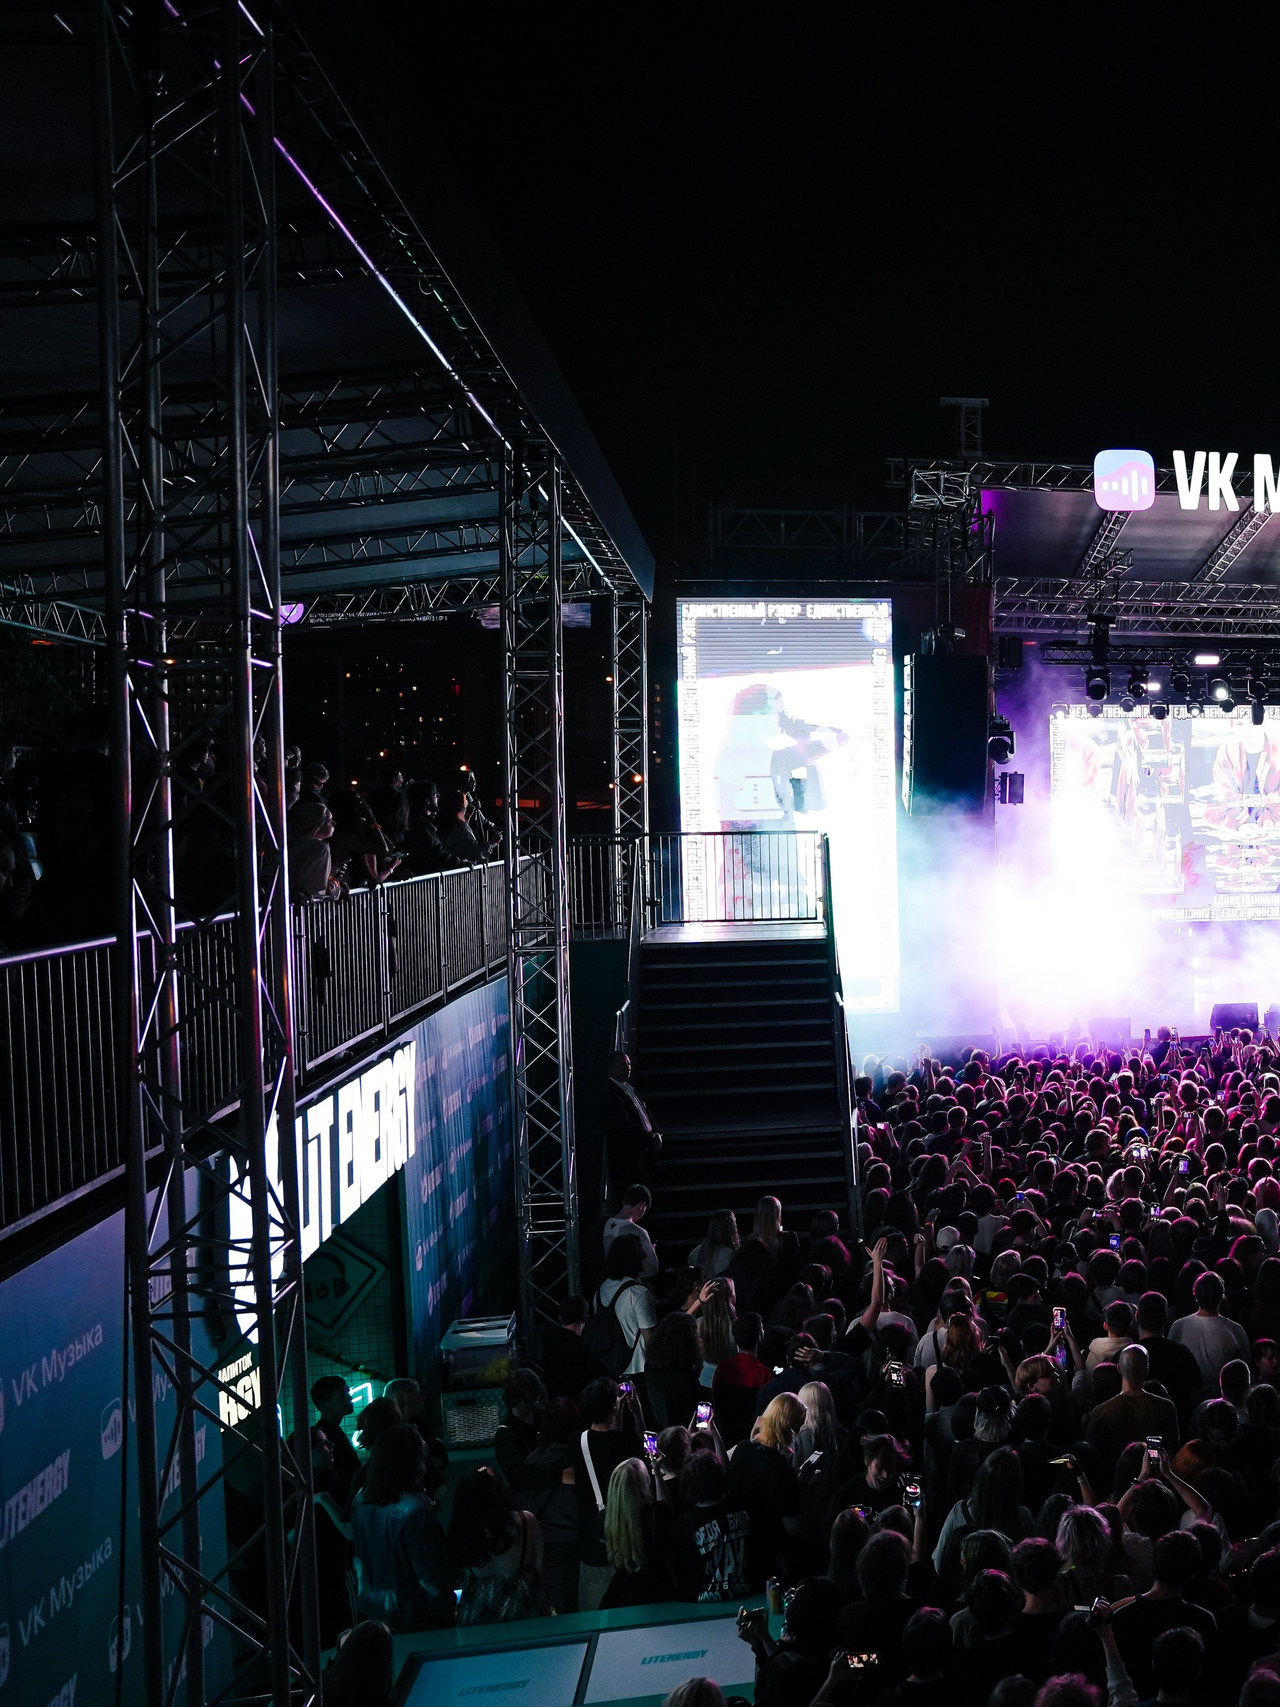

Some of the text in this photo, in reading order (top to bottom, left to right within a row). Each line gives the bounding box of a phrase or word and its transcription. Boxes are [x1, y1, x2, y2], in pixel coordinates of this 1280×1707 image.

[1172, 449, 1240, 512] VK
[12, 1323, 103, 1407] VK Музыка
[18, 1596, 47, 1647] VK
[49, 1536, 113, 1618] Музыка
